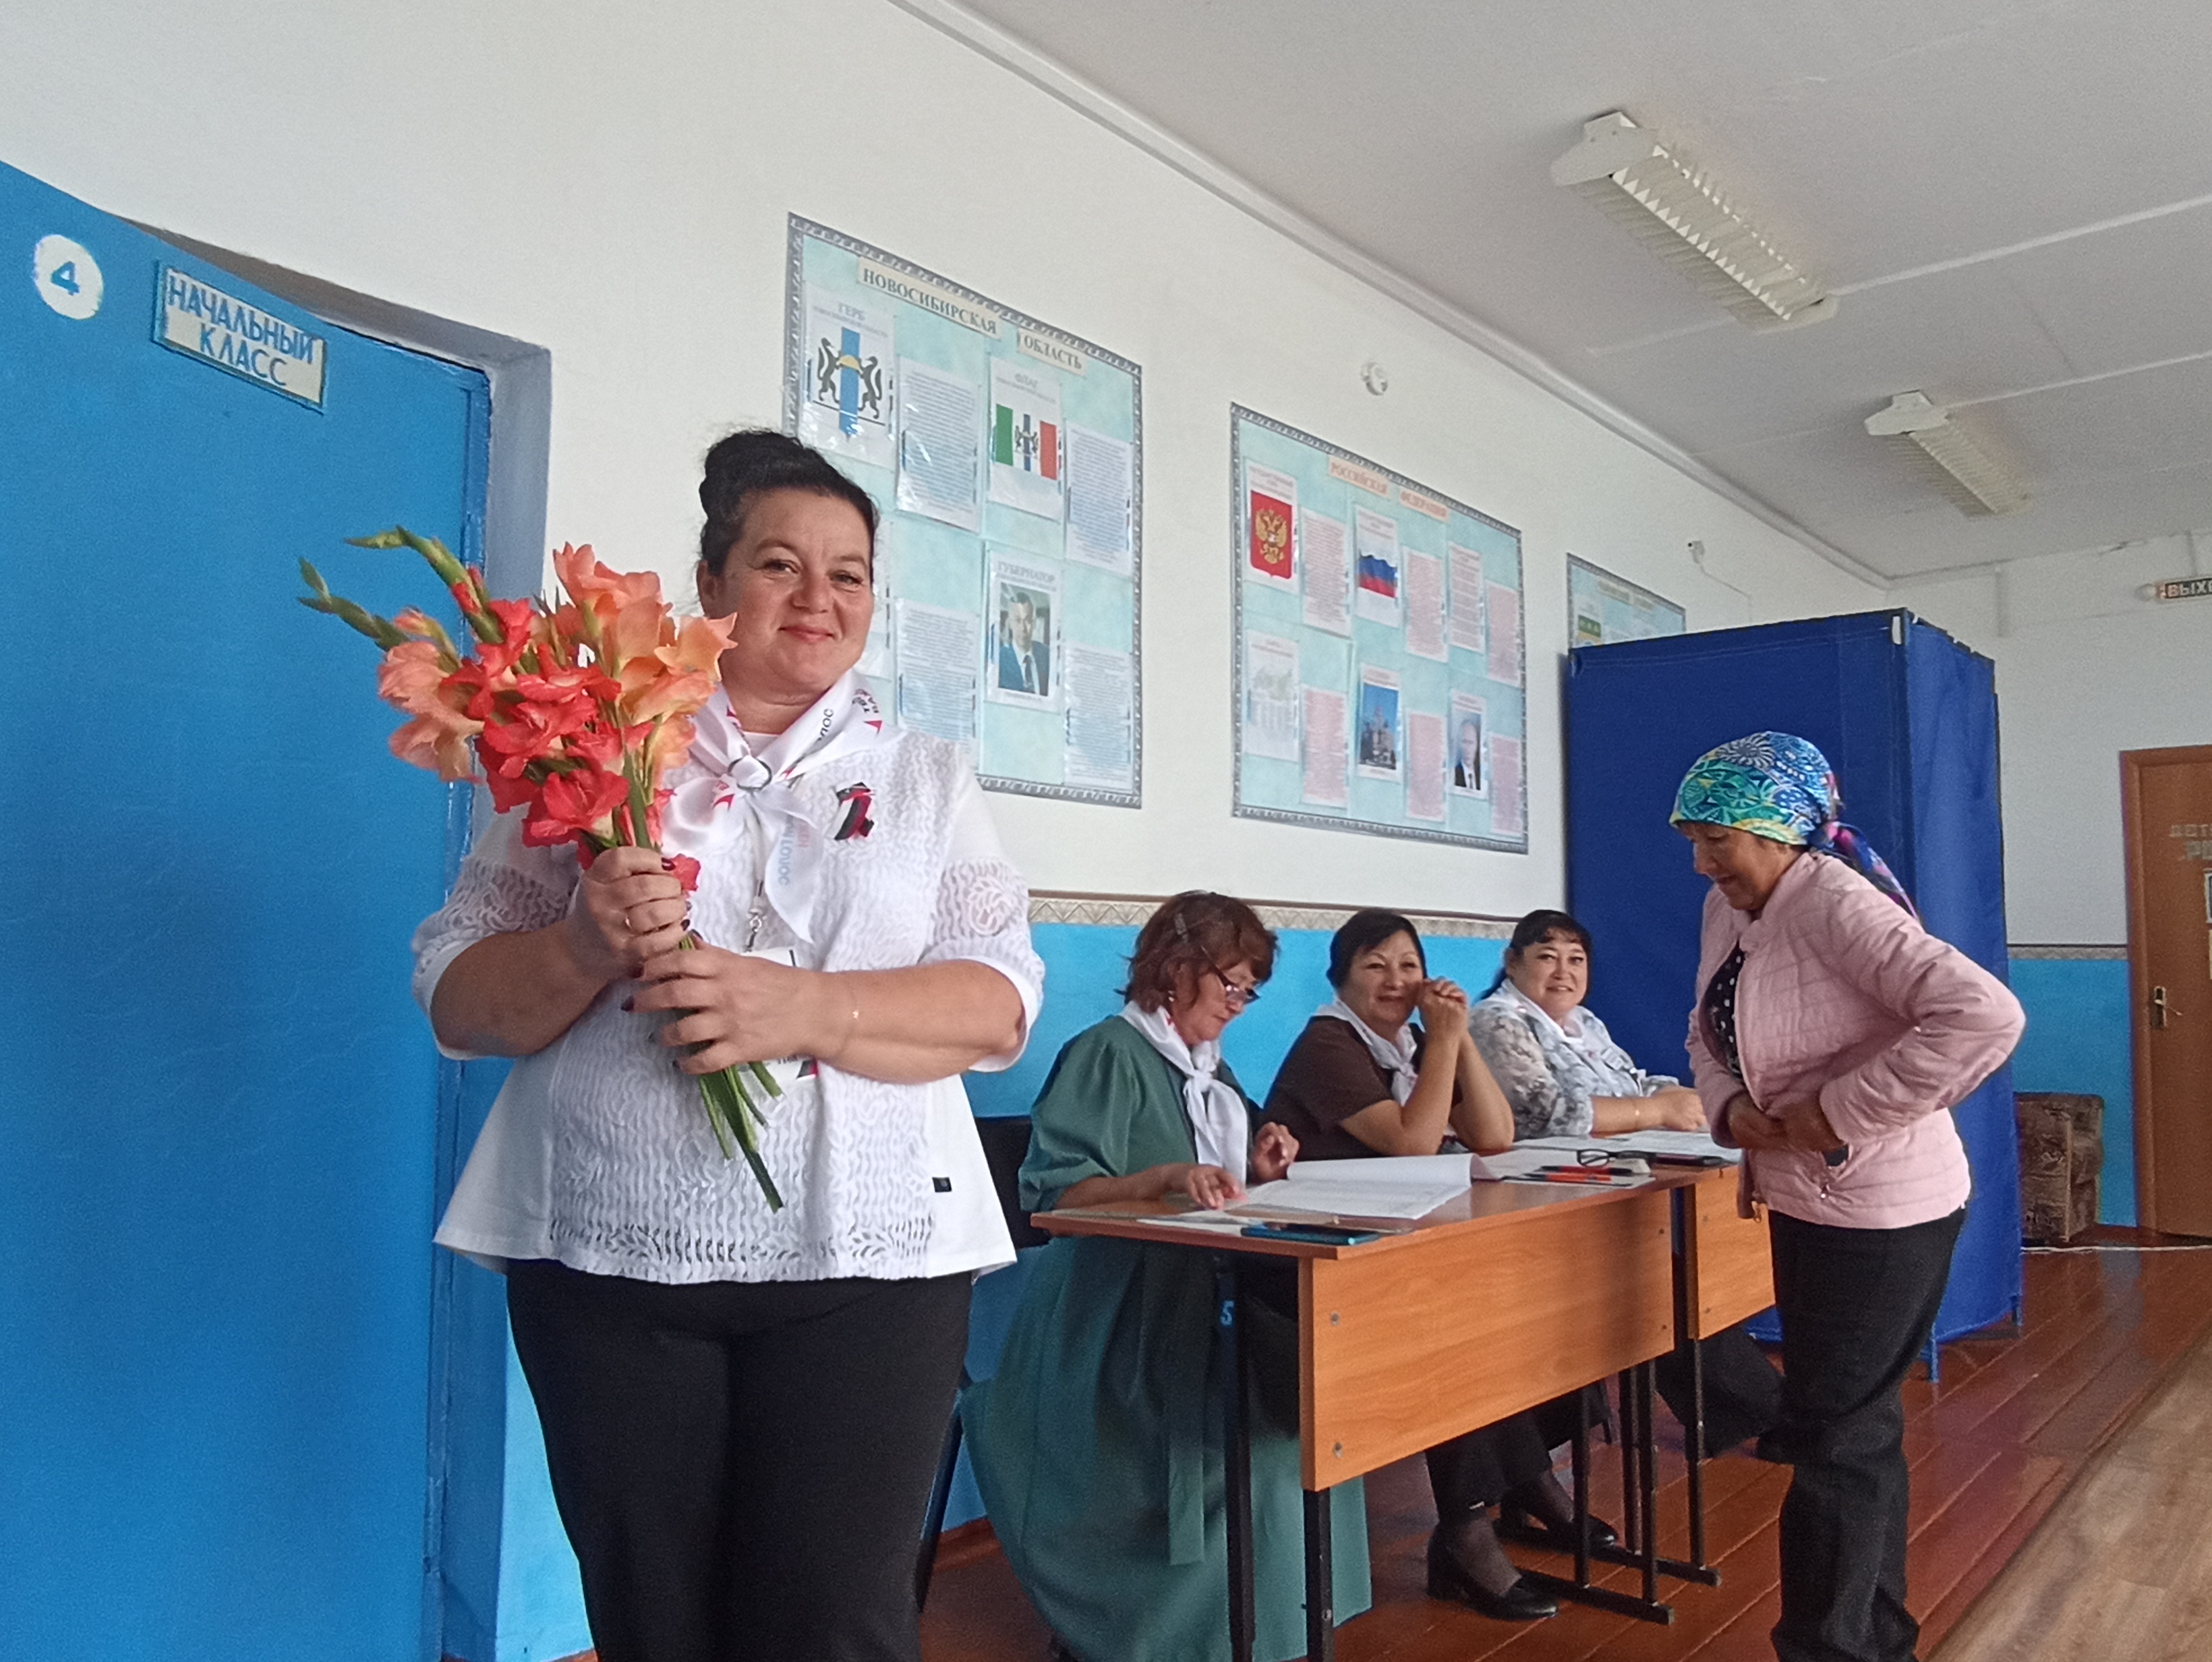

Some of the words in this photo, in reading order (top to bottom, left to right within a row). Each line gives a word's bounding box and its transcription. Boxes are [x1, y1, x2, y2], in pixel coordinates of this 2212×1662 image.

[51, 261, 80, 296] 4
[167, 275, 315, 365] НАЧАЛЬНЫЙ
[200, 322, 287, 386] КЛАСС
[863, 268, 997, 335] НОВОСИБИРСКАЯ
[1024, 335, 1082, 370] ОБЛАСТЬ
